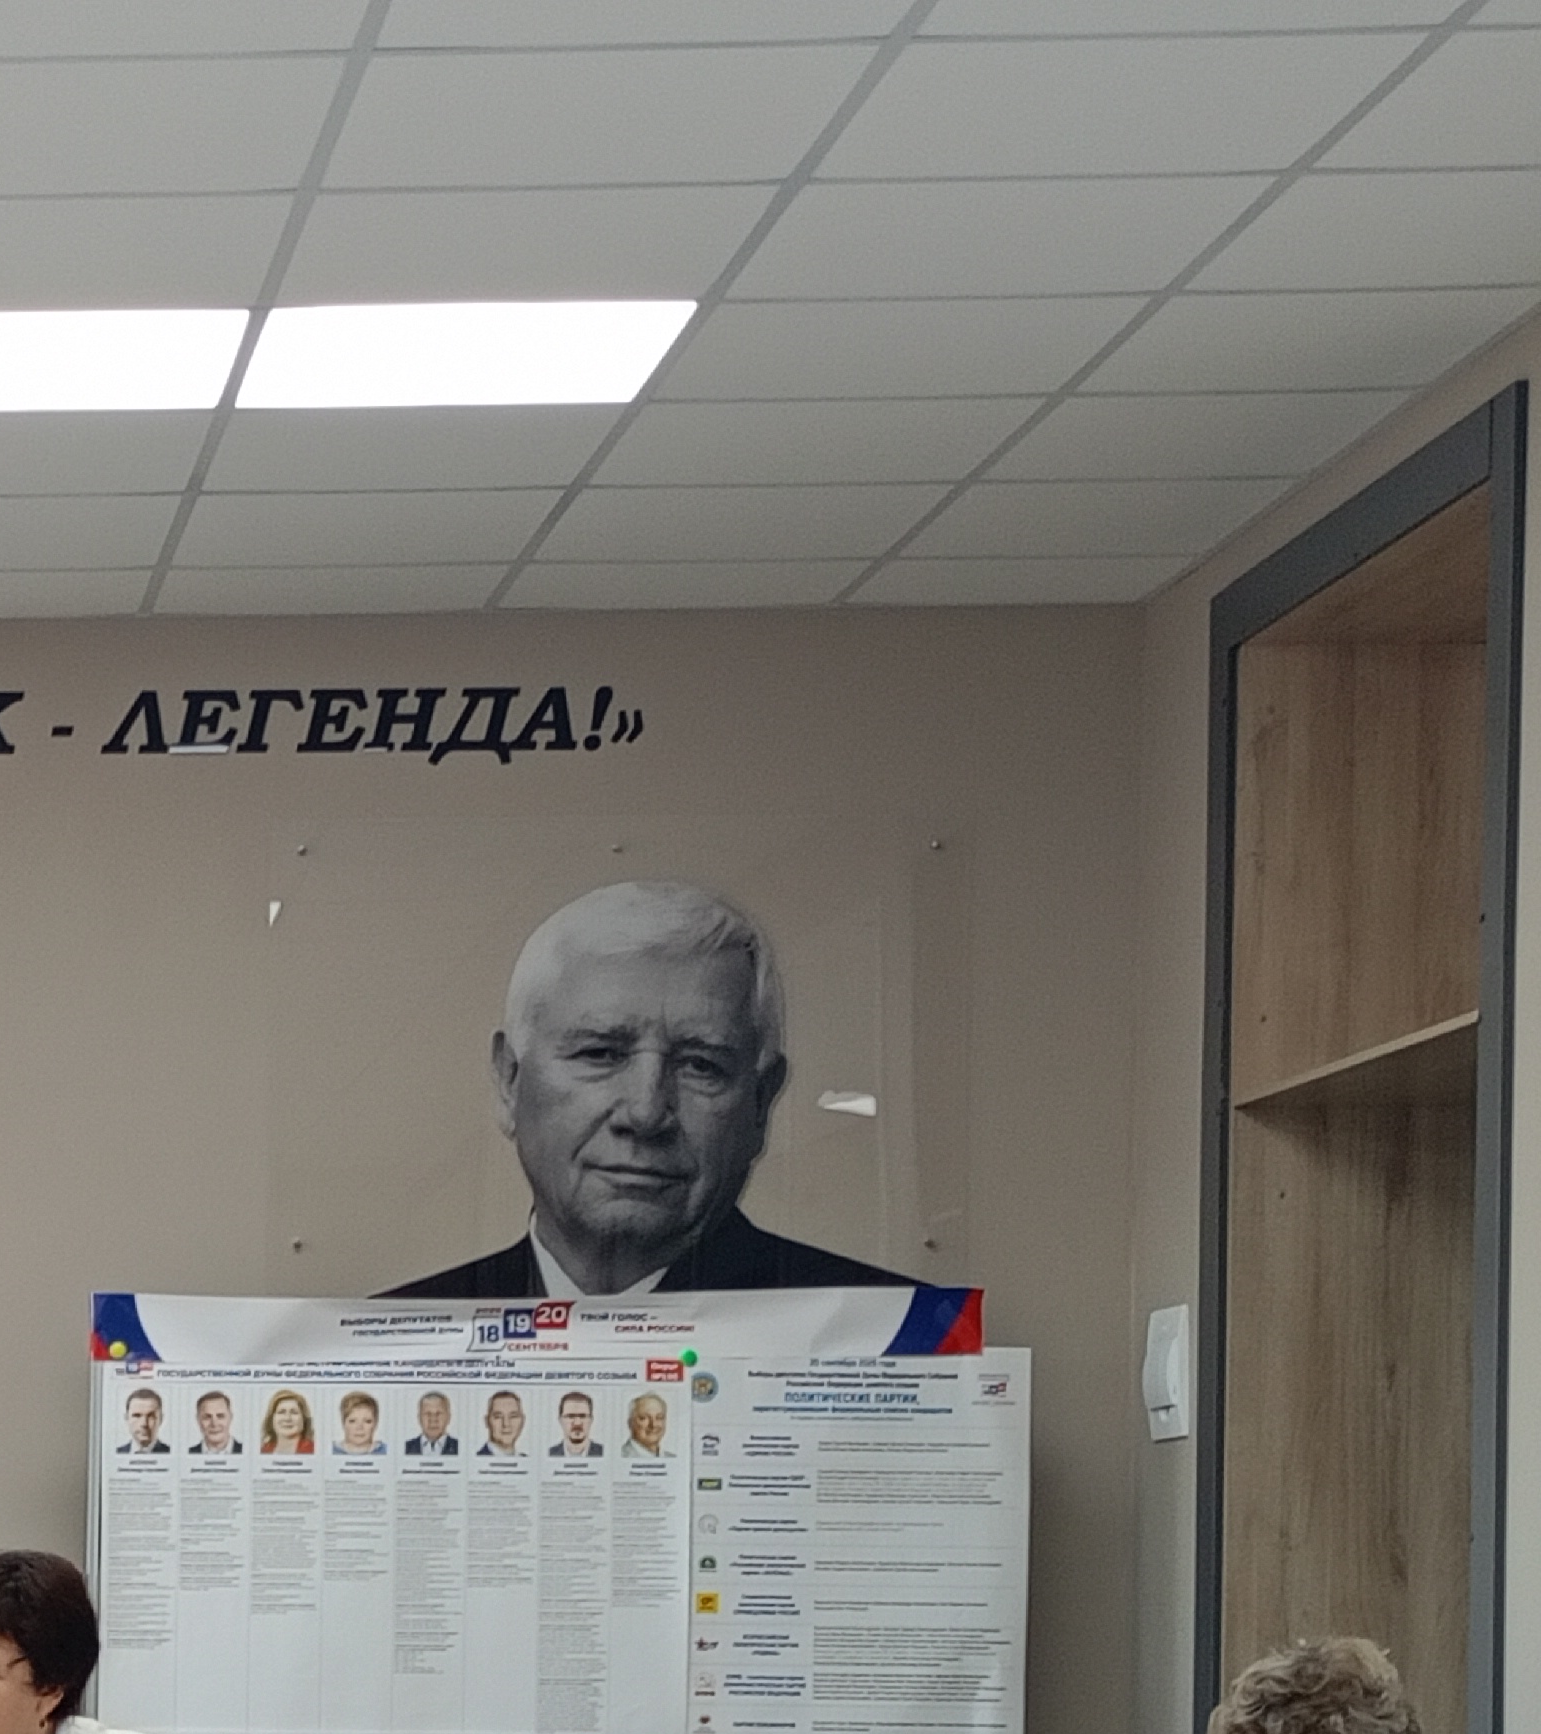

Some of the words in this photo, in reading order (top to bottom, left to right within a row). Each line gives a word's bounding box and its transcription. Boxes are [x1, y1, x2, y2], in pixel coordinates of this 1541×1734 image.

[104, 686, 643, 763] ЛЕГЕНДА!»
[506, 1313, 531, 1333] 19
[536, 1305, 567, 1324] 20
[477, 1324, 500, 1343] 18
[784, 1391, 871, 1403] ПОЛИТИЧЕСКИЕ
